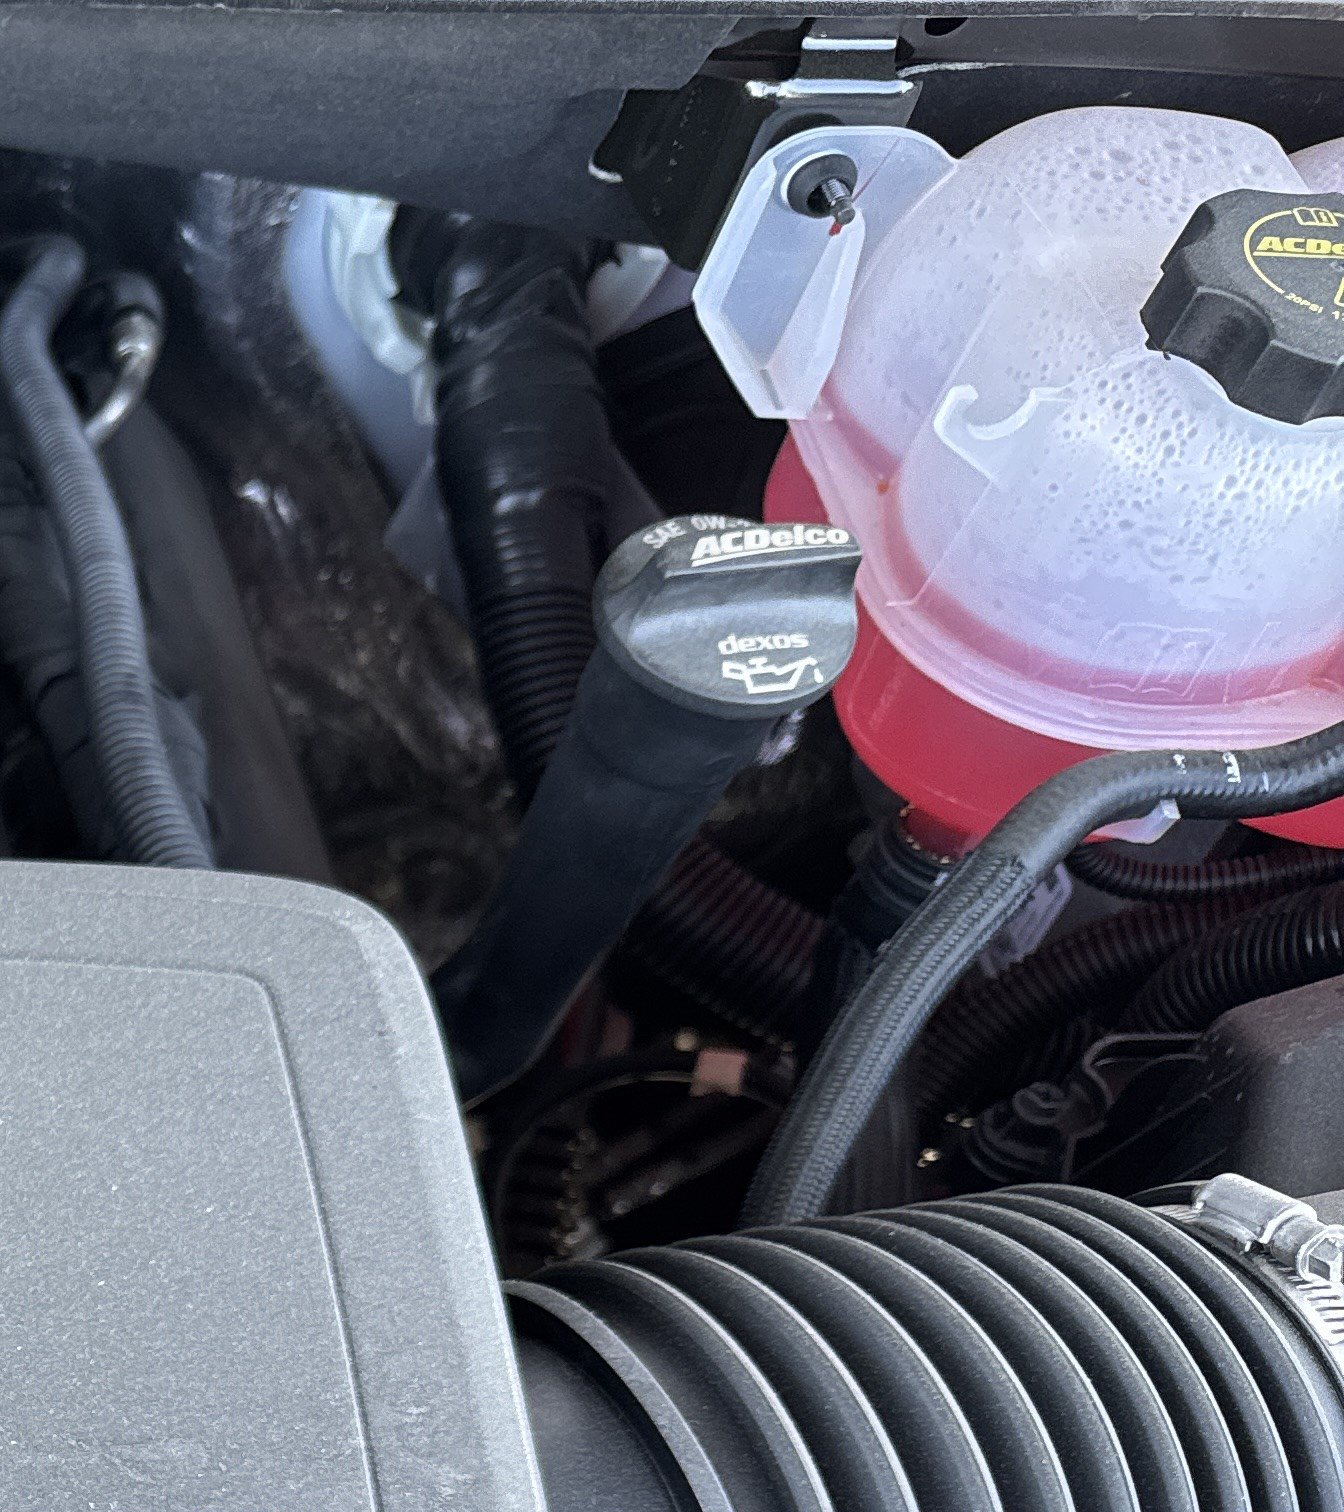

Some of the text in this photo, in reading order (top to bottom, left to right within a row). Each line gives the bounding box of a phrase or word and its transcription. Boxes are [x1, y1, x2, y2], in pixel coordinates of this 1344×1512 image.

[1284, 292, 1324, 314] 20PSI
[642, 520, 686, 549] SAE
[690, 525, 850, 562] ACDelco
[718, 632, 810, 655] dexos
